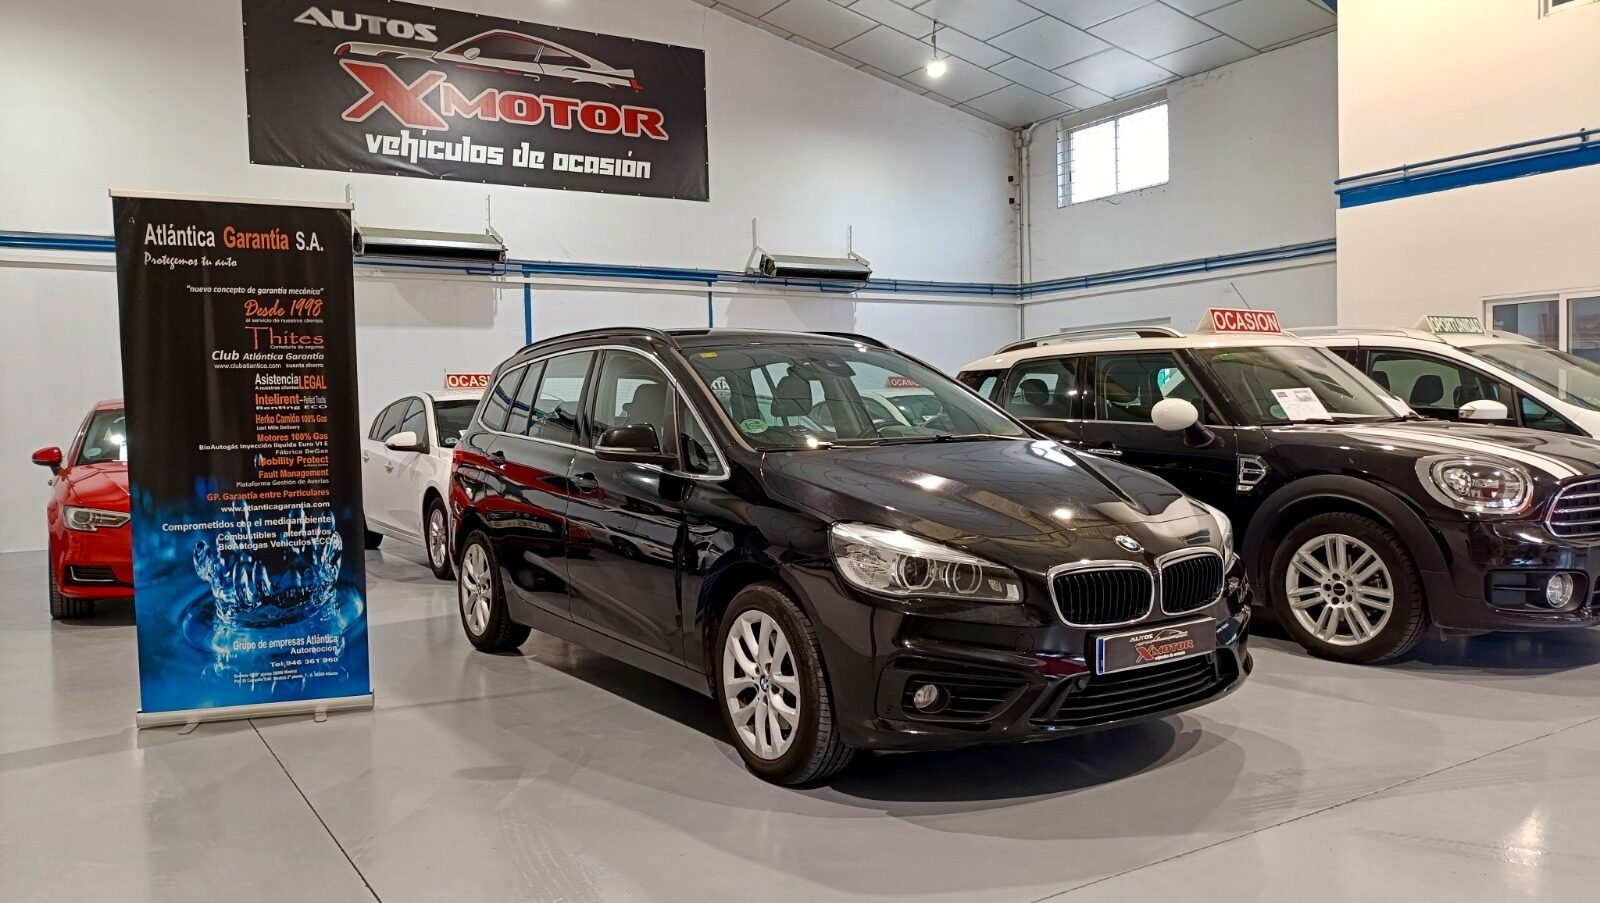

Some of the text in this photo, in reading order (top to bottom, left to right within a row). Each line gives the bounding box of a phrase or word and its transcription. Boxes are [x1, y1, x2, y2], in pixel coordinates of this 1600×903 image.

[293, 6, 438, 43] AUTOS
[339, 58, 669, 141] XMOTOR
[365, 129, 651, 179] vehículos de ocasión
[144, 223, 324, 252] Atlántica Garantía S.A.
[144, 251, 238, 270] Protegemos tu auto
[213, 286, 246, 295] concepto
[246, 286, 256, 294] de
[257, 286, 288, 296] garantía
[244, 298, 323, 317] Desde 1998
[1213, 311, 1279, 331] OCASION
[1428, 316, 1484, 334] OPORTUNIDAD
[244, 326, 325, 350] Thites
[211, 350, 325, 361] Club Atlántica Garantía
[255, 373, 327, 390] Asistencia LEGAL
[255, 413, 328, 424] Herko Camión 100% Gas
[257, 432, 328, 442] Motores 100% Gas
[258, 455, 329, 467] Mobility Protect
[258, 468, 329, 479] Fault Management
[206, 493, 222, 501] GP.
[259, 490, 282, 498] entre
[283, 488, 330, 497] Particulares
[162, 521, 235, 533] Comprometidos
[253, 518, 263, 527] el
[217, 528, 332, 541] Combustibles alternativos
[233, 633, 338, 651] Grupo de empresas Atlántica
[1129, 633, 1154, 643] AUTOS
[304, 657, 320, 665] 361
[322, 656, 339, 664] 960
